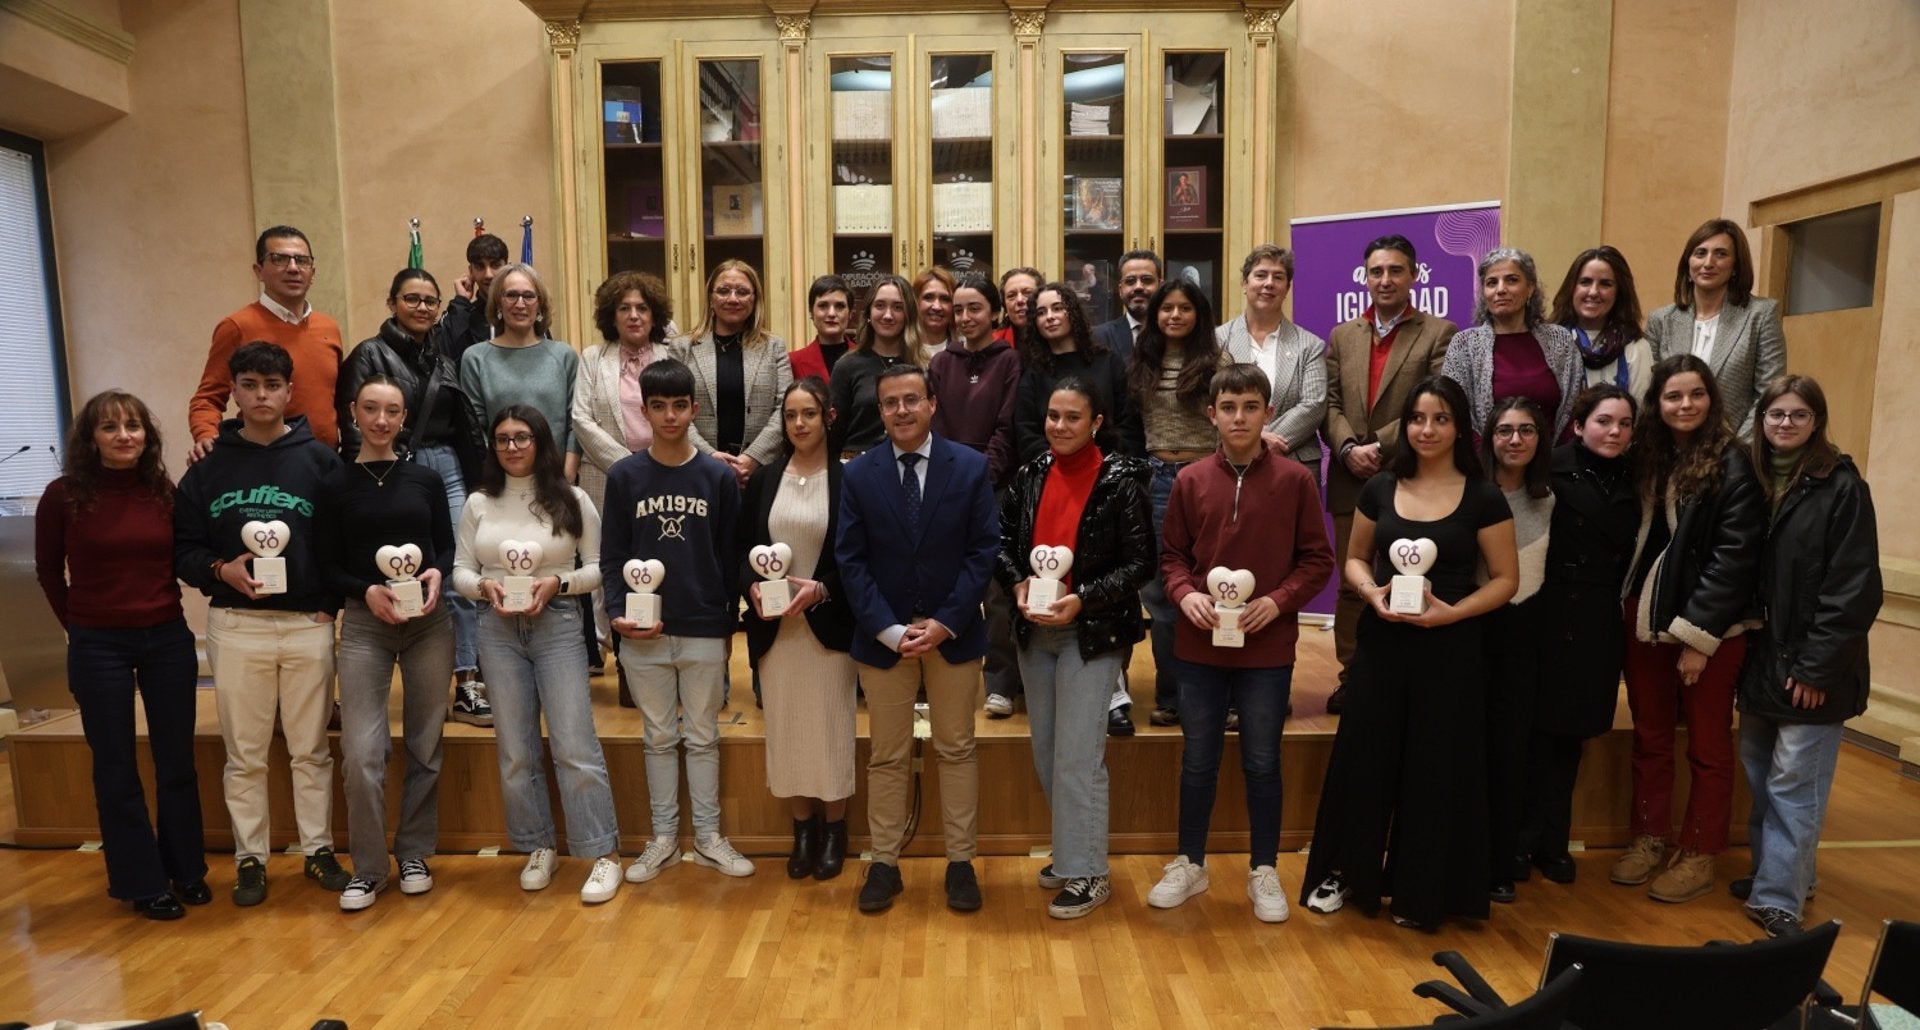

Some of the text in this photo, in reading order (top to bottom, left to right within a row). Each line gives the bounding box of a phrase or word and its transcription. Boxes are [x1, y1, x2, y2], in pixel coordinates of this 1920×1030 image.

[1336, 285, 1449, 324] IGUDAD
[209, 484, 315, 519] scuffers
[635, 494, 709, 519] AM1976
[666, 520, 677, 535] A
